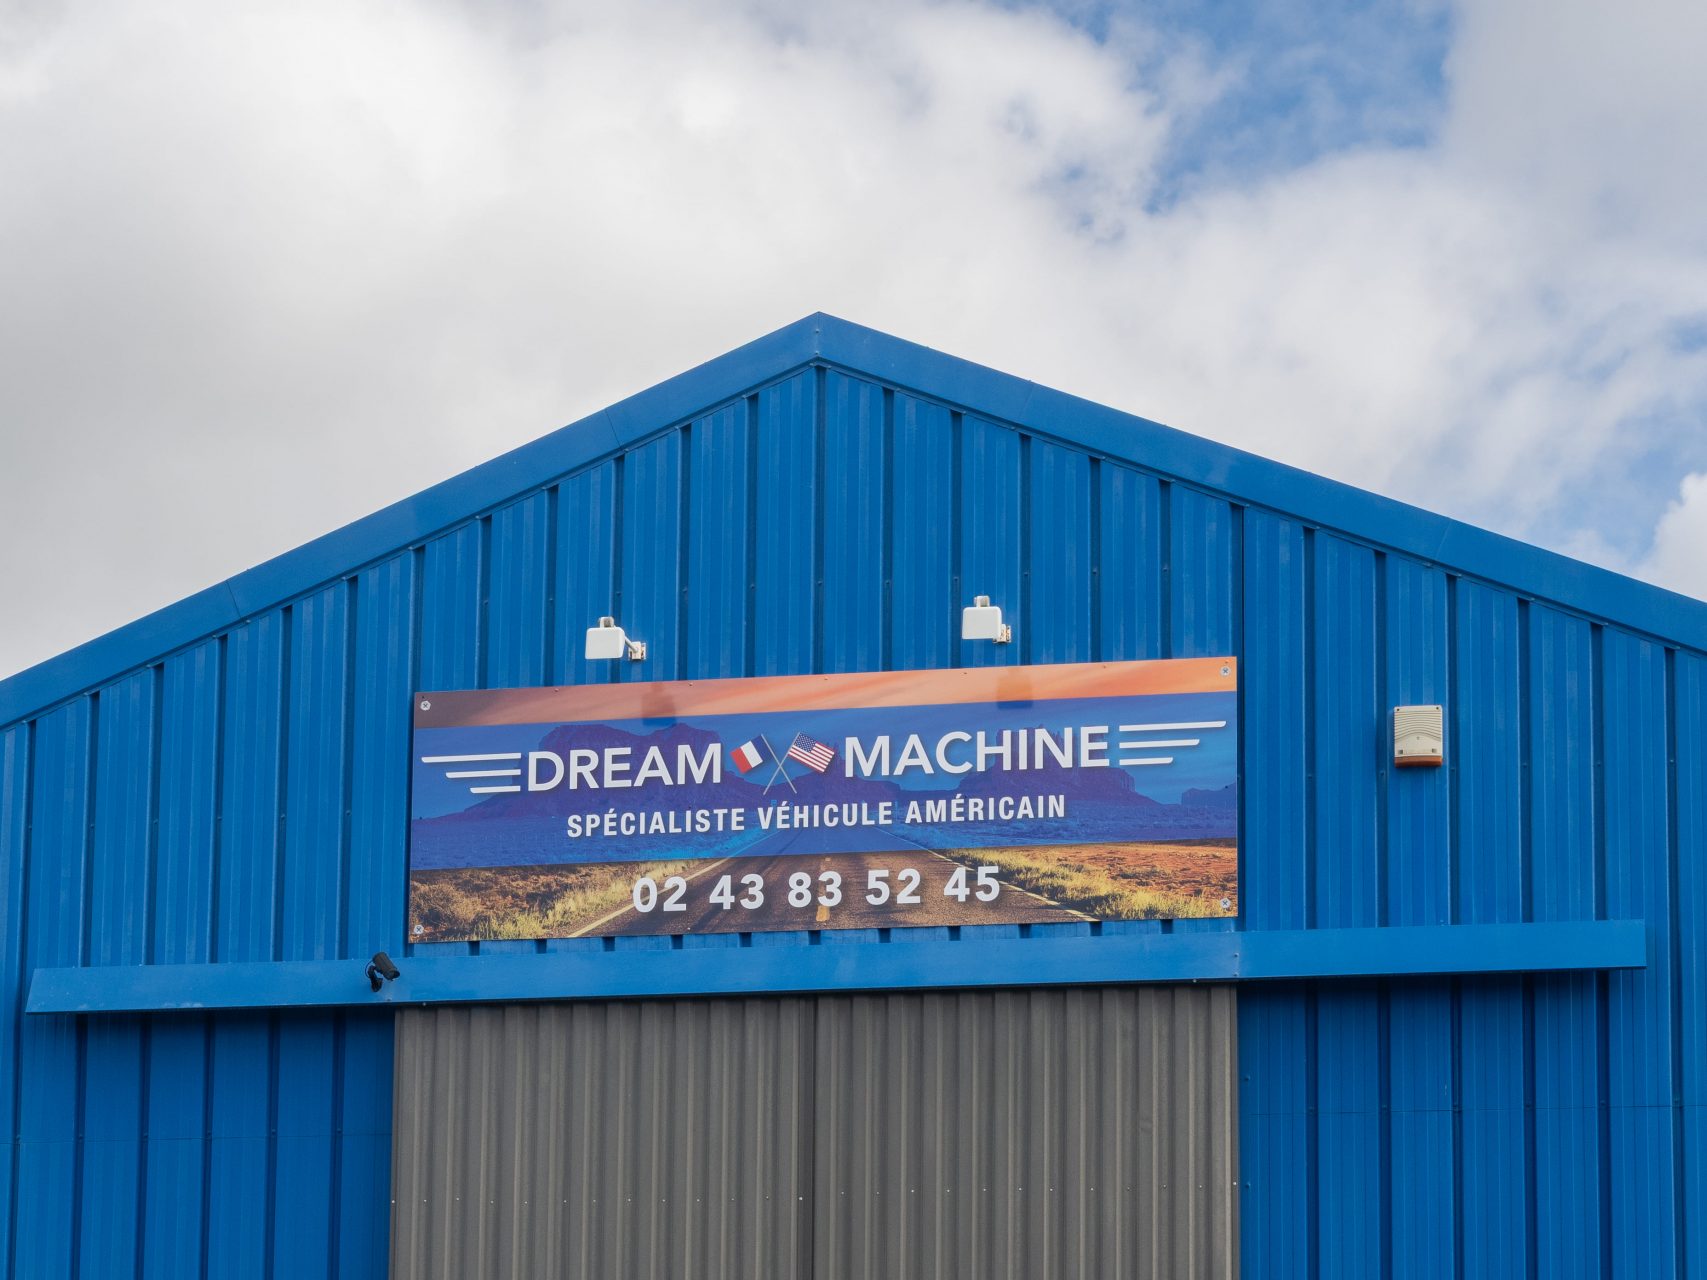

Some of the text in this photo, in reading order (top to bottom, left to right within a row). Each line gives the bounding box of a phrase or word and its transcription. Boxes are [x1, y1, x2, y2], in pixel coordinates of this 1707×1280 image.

[527, 725, 1110, 792] DREAM MACHINE
[567, 793, 1065, 838] SPÉCIALISTE VÉHICULE AMÉRICAIN
[632, 865, 1001, 913] 02 43 83 52 45
